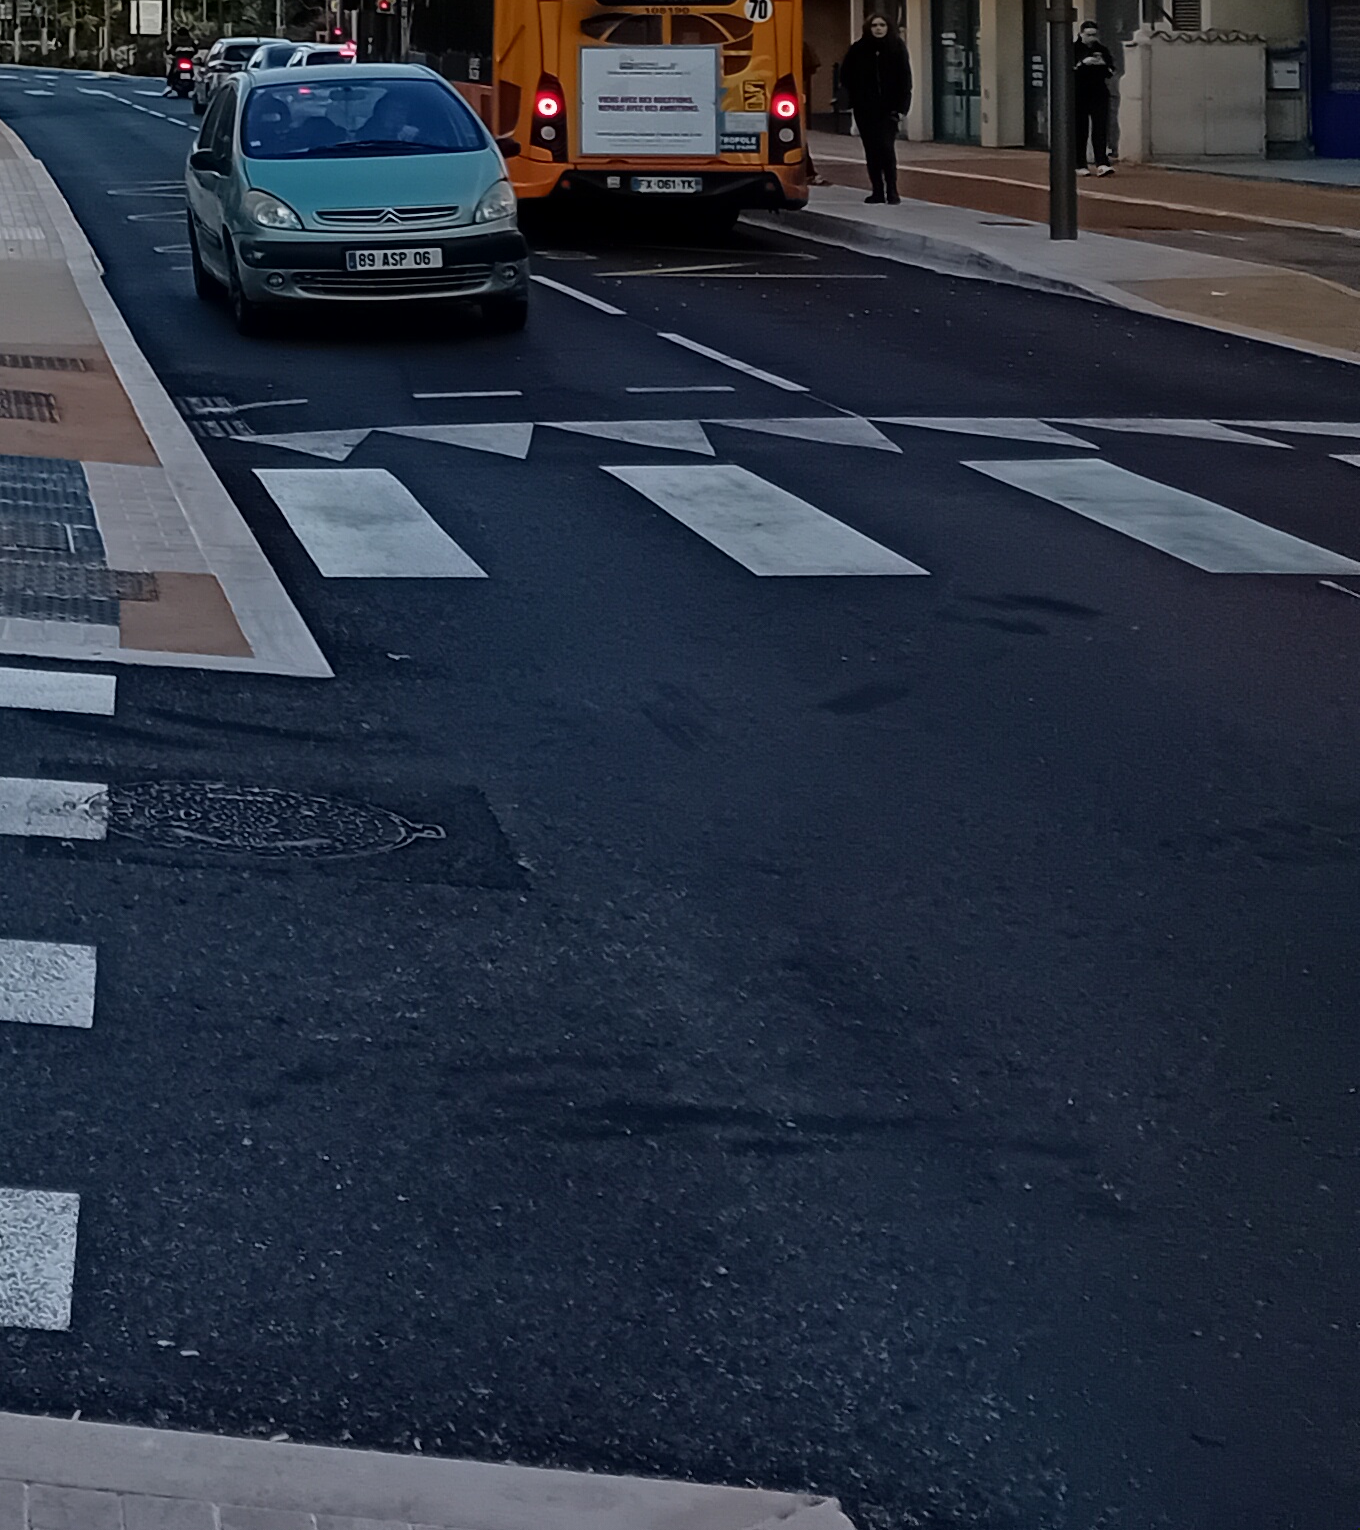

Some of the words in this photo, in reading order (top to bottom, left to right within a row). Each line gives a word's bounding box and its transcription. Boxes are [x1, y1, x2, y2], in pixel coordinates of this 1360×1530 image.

[748, 0, 767, 20] 70
[358, 252, 376, 268] 89
[382, 251, 408, 267] ASP
[413, 250, 432, 266] 06
